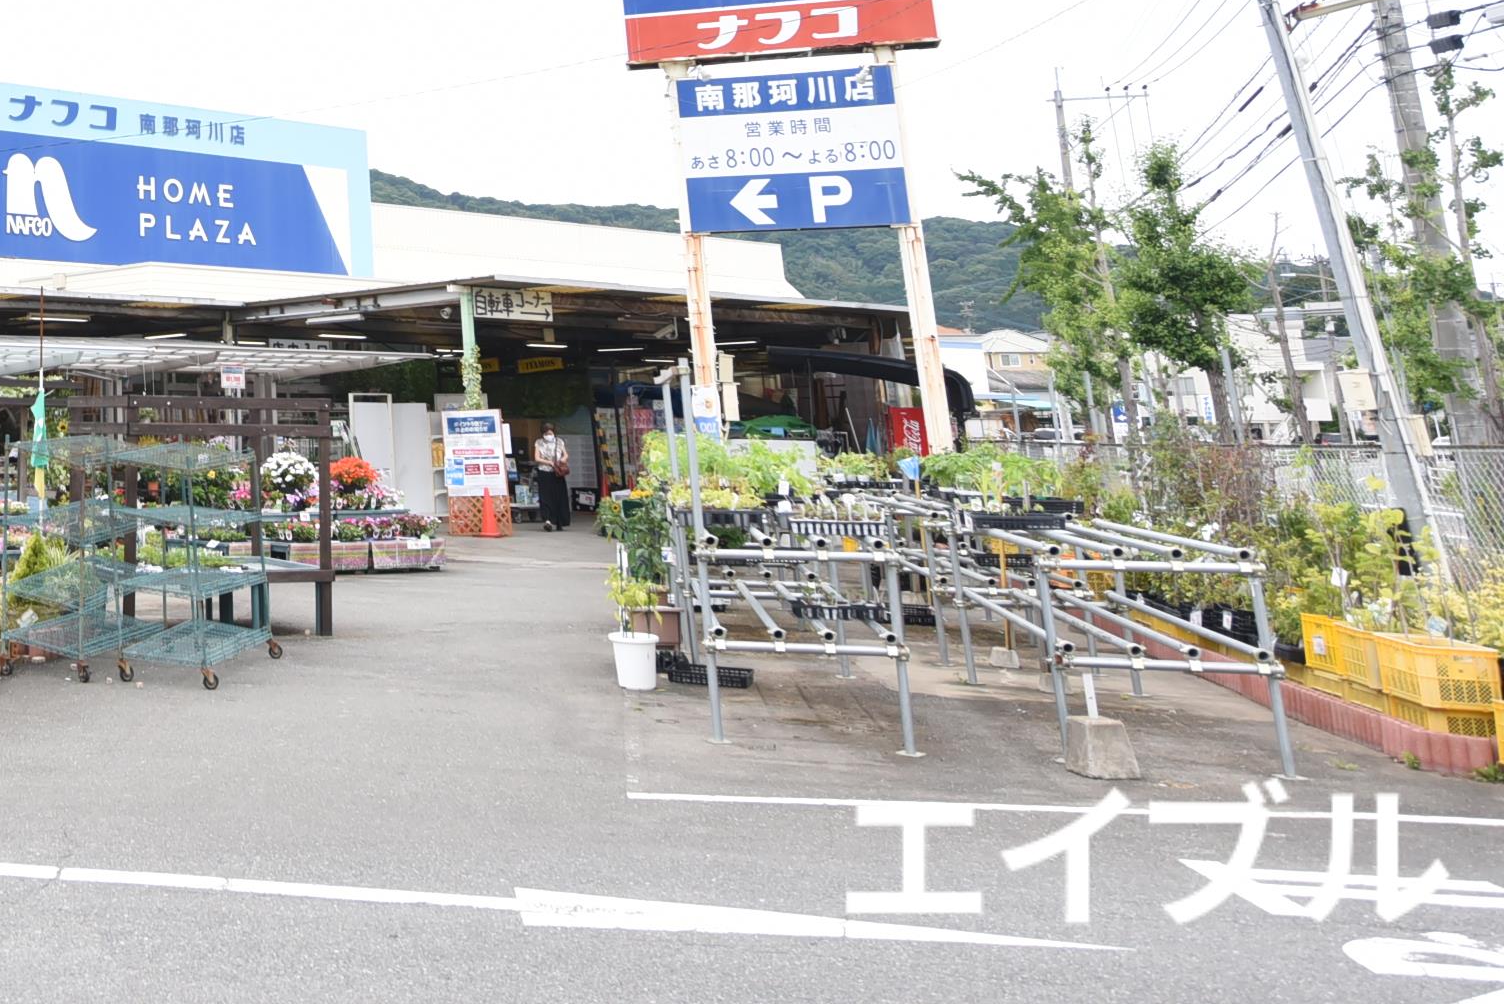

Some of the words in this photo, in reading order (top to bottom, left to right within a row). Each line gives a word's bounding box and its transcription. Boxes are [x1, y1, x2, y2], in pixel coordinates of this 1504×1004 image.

[696, 6, 858, 50] ナフコ
[694, 74, 875, 112] 南那珂川店
[8, 94, 117, 132] ナフコ
[139, 113, 245, 146] 南那珂川店
[744, 116, 832, 138] 営業時間
[137, 174, 234, 208] HOME
[808, 175, 853, 224] P
[5, 214, 53, 237] NAFCO
[139, 212, 256, 246] PLAZA
